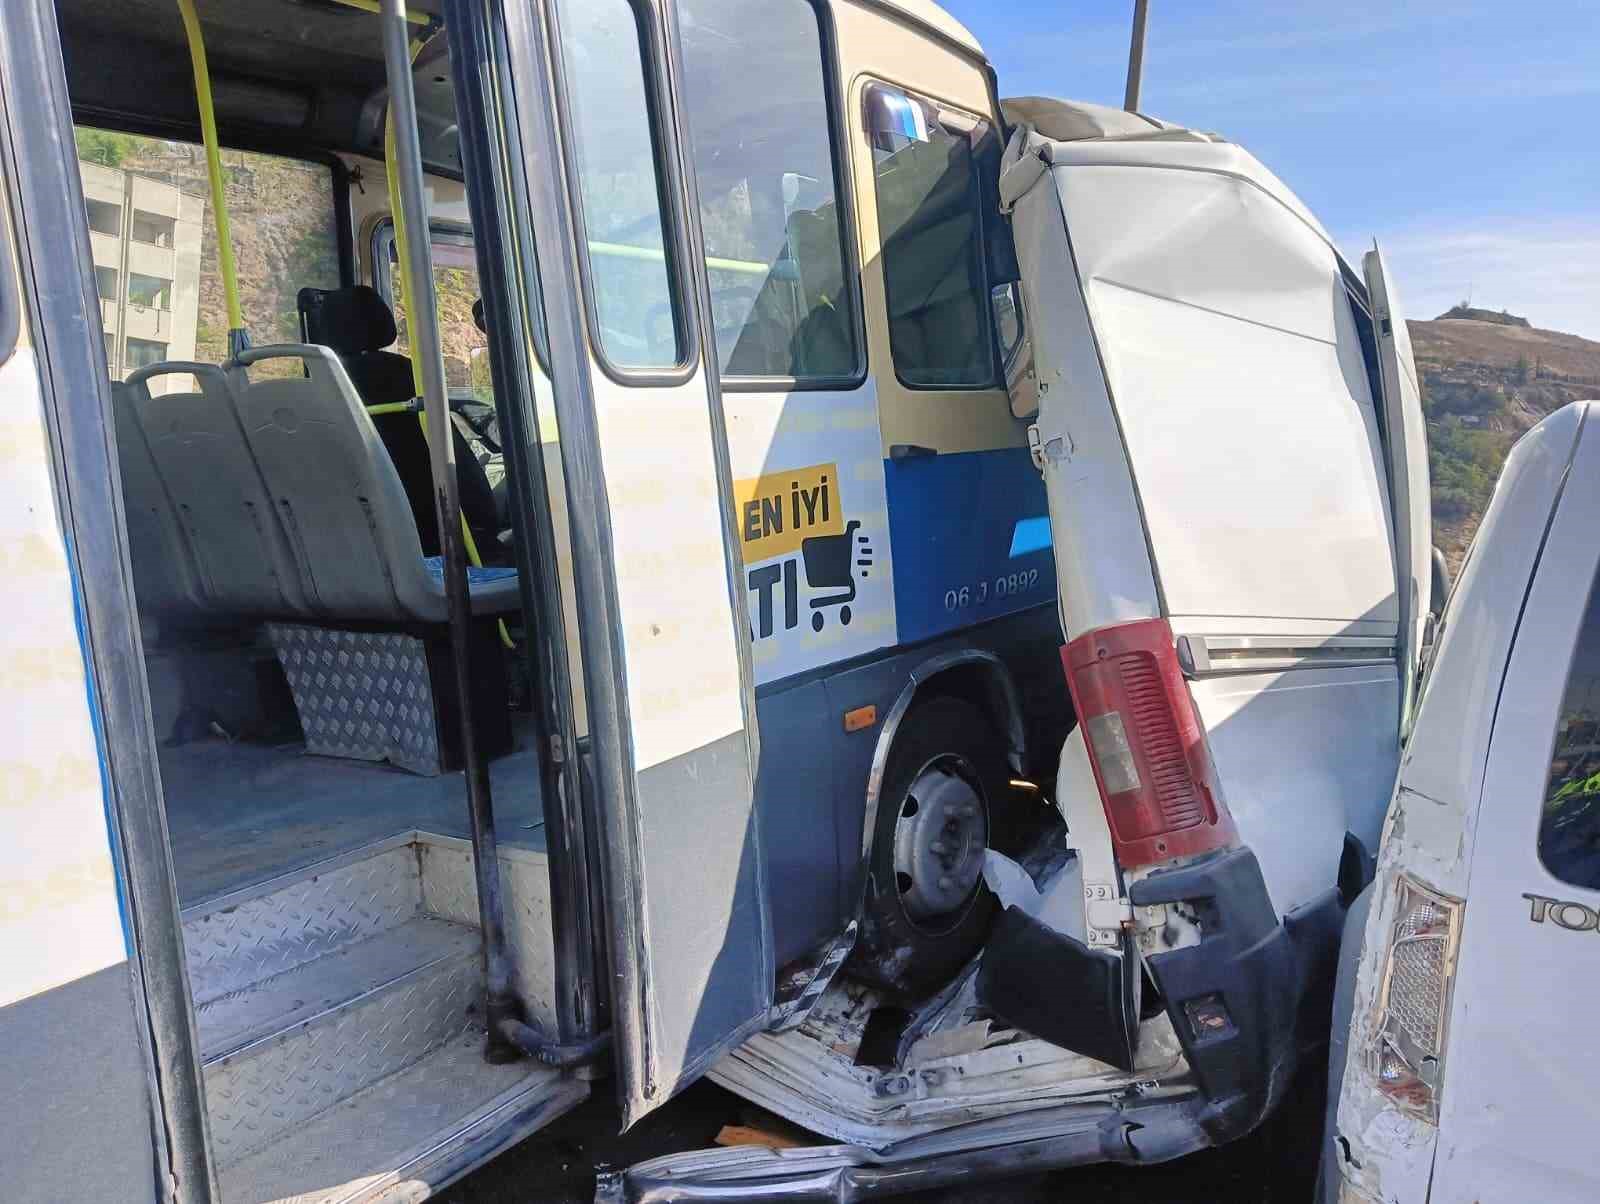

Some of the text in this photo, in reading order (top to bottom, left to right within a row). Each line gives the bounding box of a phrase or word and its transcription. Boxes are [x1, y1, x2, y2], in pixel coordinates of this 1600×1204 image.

[743, 475, 830, 542] EN İYİ
[748, 558, 798, 643] TI
[944, 586, 969, 612] 06
[996, 568, 1038, 594] 0892
[1521, 892, 1600, 934] TO
